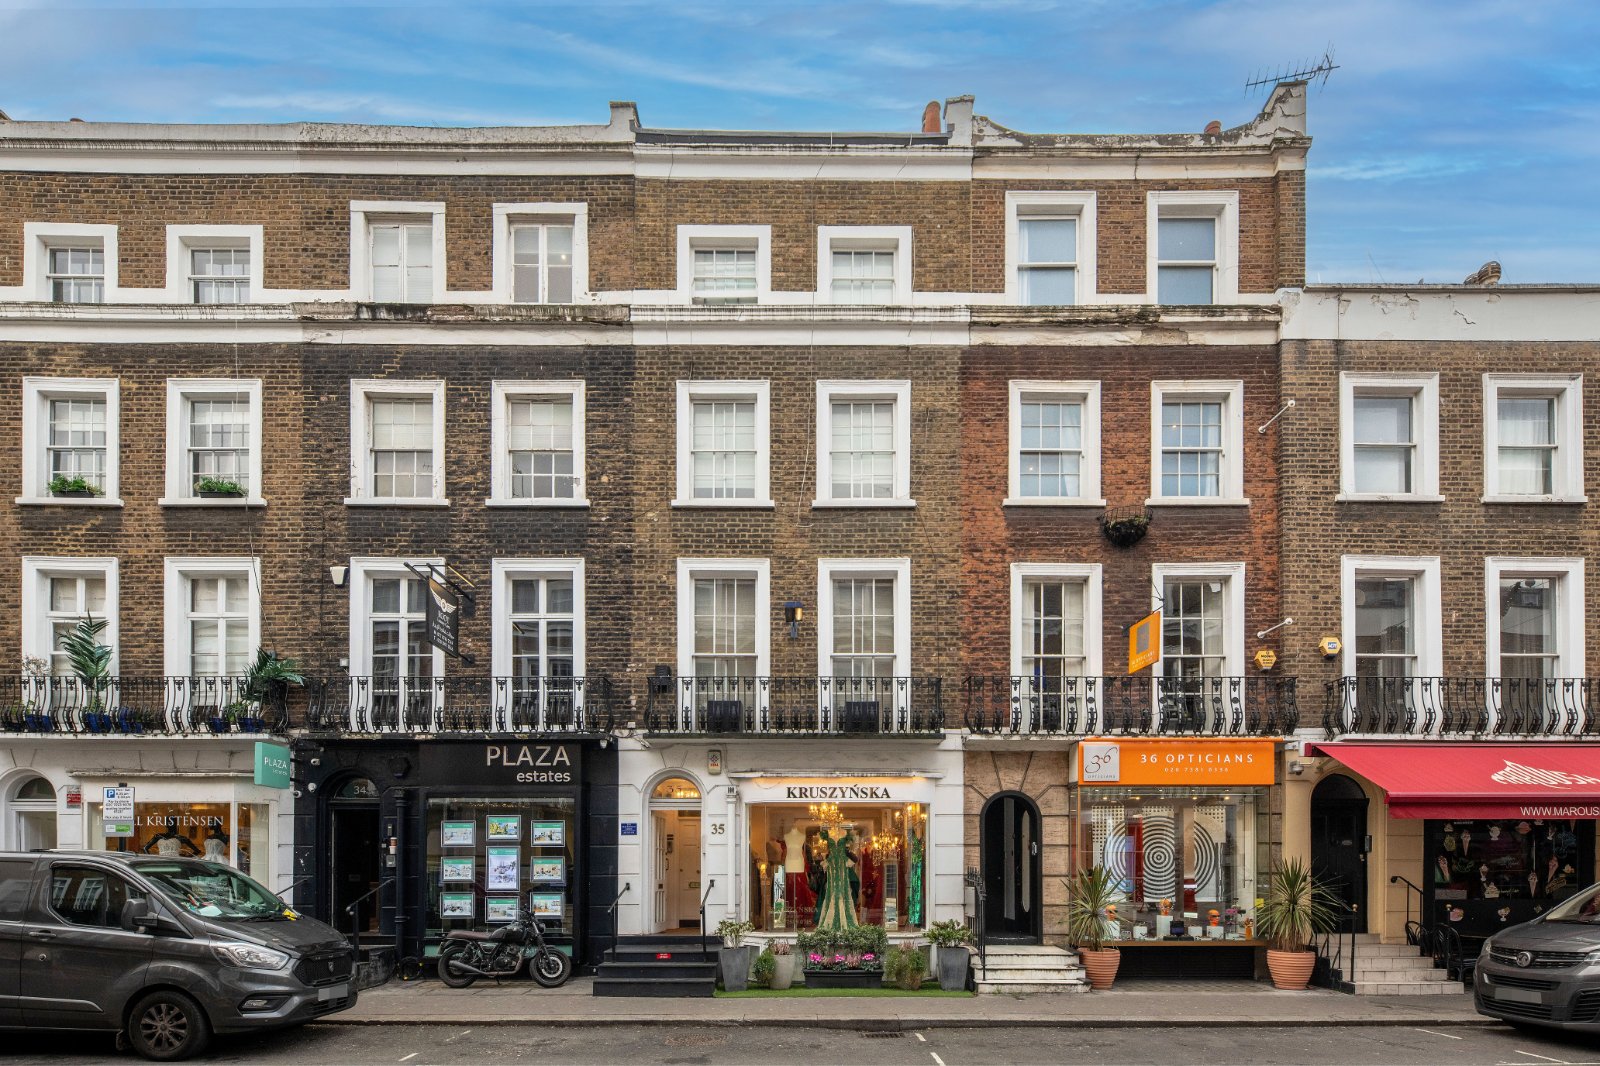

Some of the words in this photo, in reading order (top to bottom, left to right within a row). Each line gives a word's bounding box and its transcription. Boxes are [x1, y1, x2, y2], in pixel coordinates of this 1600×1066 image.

[486, 745, 571, 766] PLAZA
[1140, 753, 1158, 764] 36
[1165, 753, 1254, 764] OPTICIANS
[264, 756, 288, 769] PLAZA
[516, 770, 571, 782] estates
[786, 783, 891, 799] KRUSZYŃSKA
[146, 815, 225, 826] KRISTENSEN
[711, 823, 725, 835] 35
